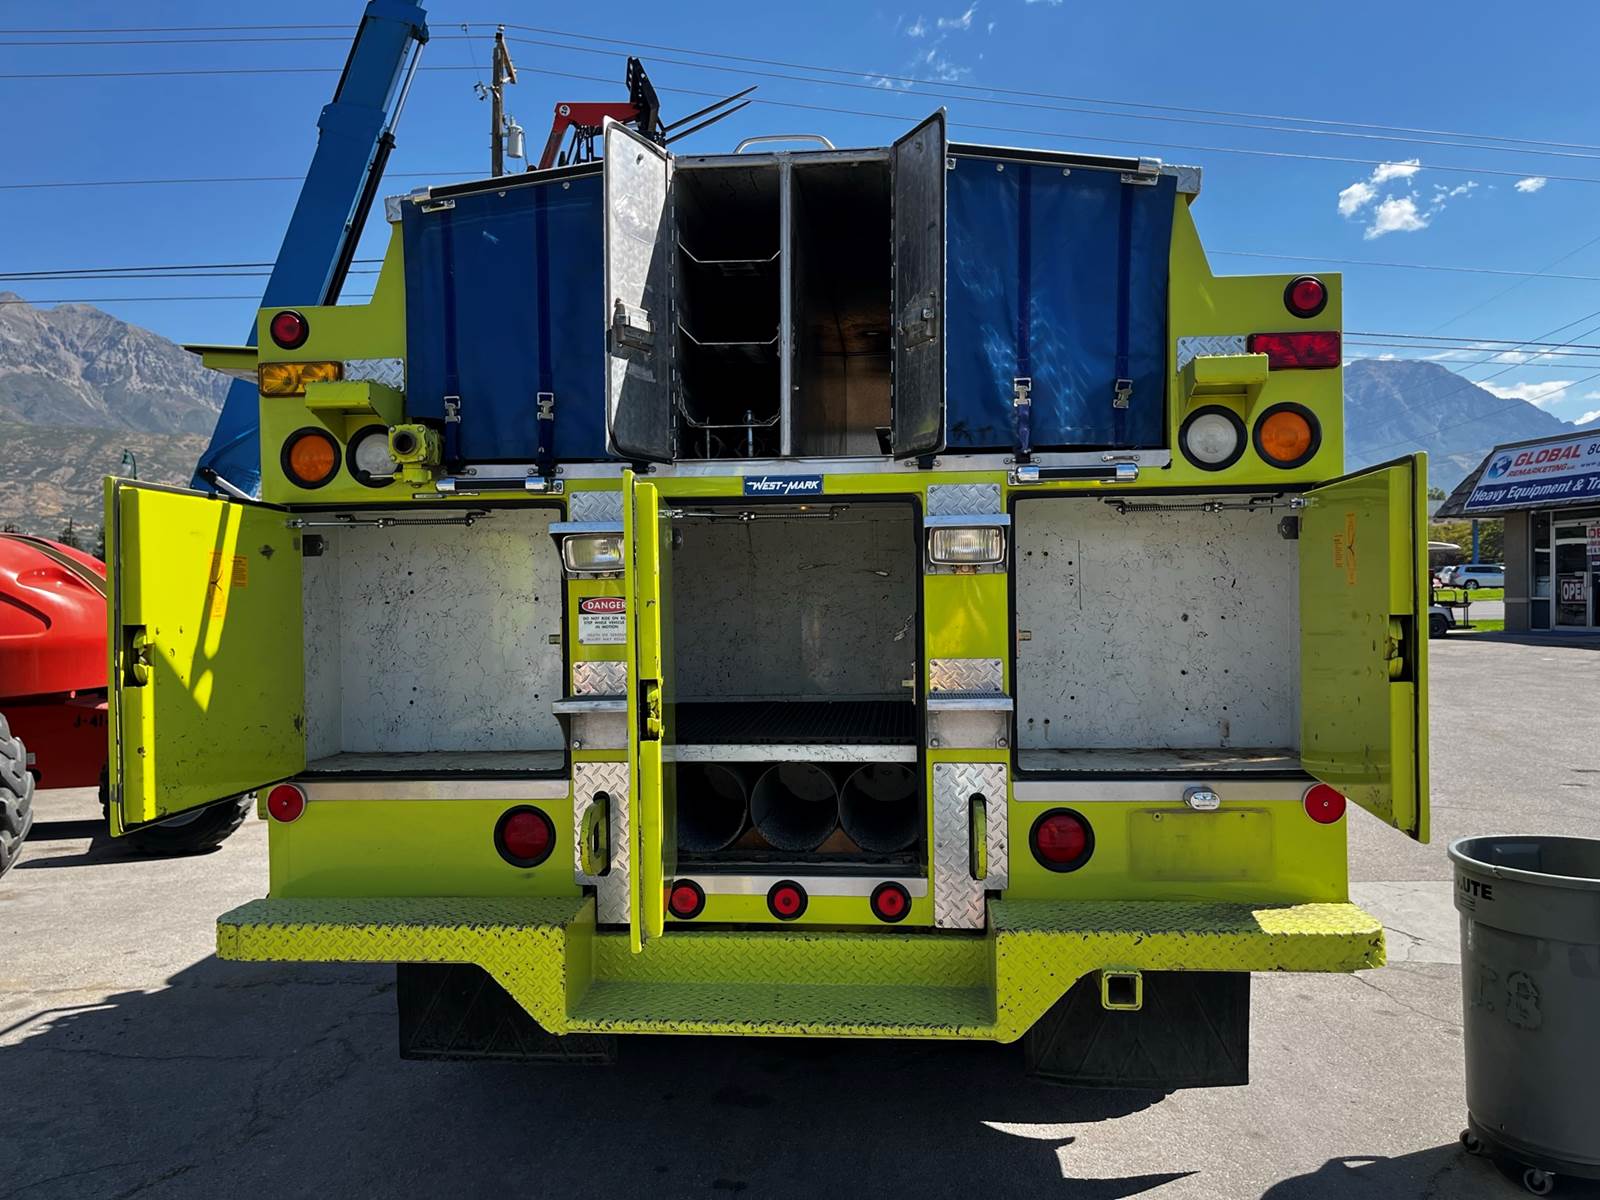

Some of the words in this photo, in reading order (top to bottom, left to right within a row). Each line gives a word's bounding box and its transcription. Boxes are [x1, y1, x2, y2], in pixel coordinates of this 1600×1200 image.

[1513, 444, 1582, 467] GLOBAL
[1507, 463, 1567, 478] REMARKETING
[746, 476, 820, 495] WEST-MARK
[1471, 489, 1507, 502] Heavy
[1507, 481, 1573, 499] Equipment
[1572, 477, 1584, 491] &
[1563, 583, 1588, 600] OPEN
[587, 601, 626, 609] DANGER
